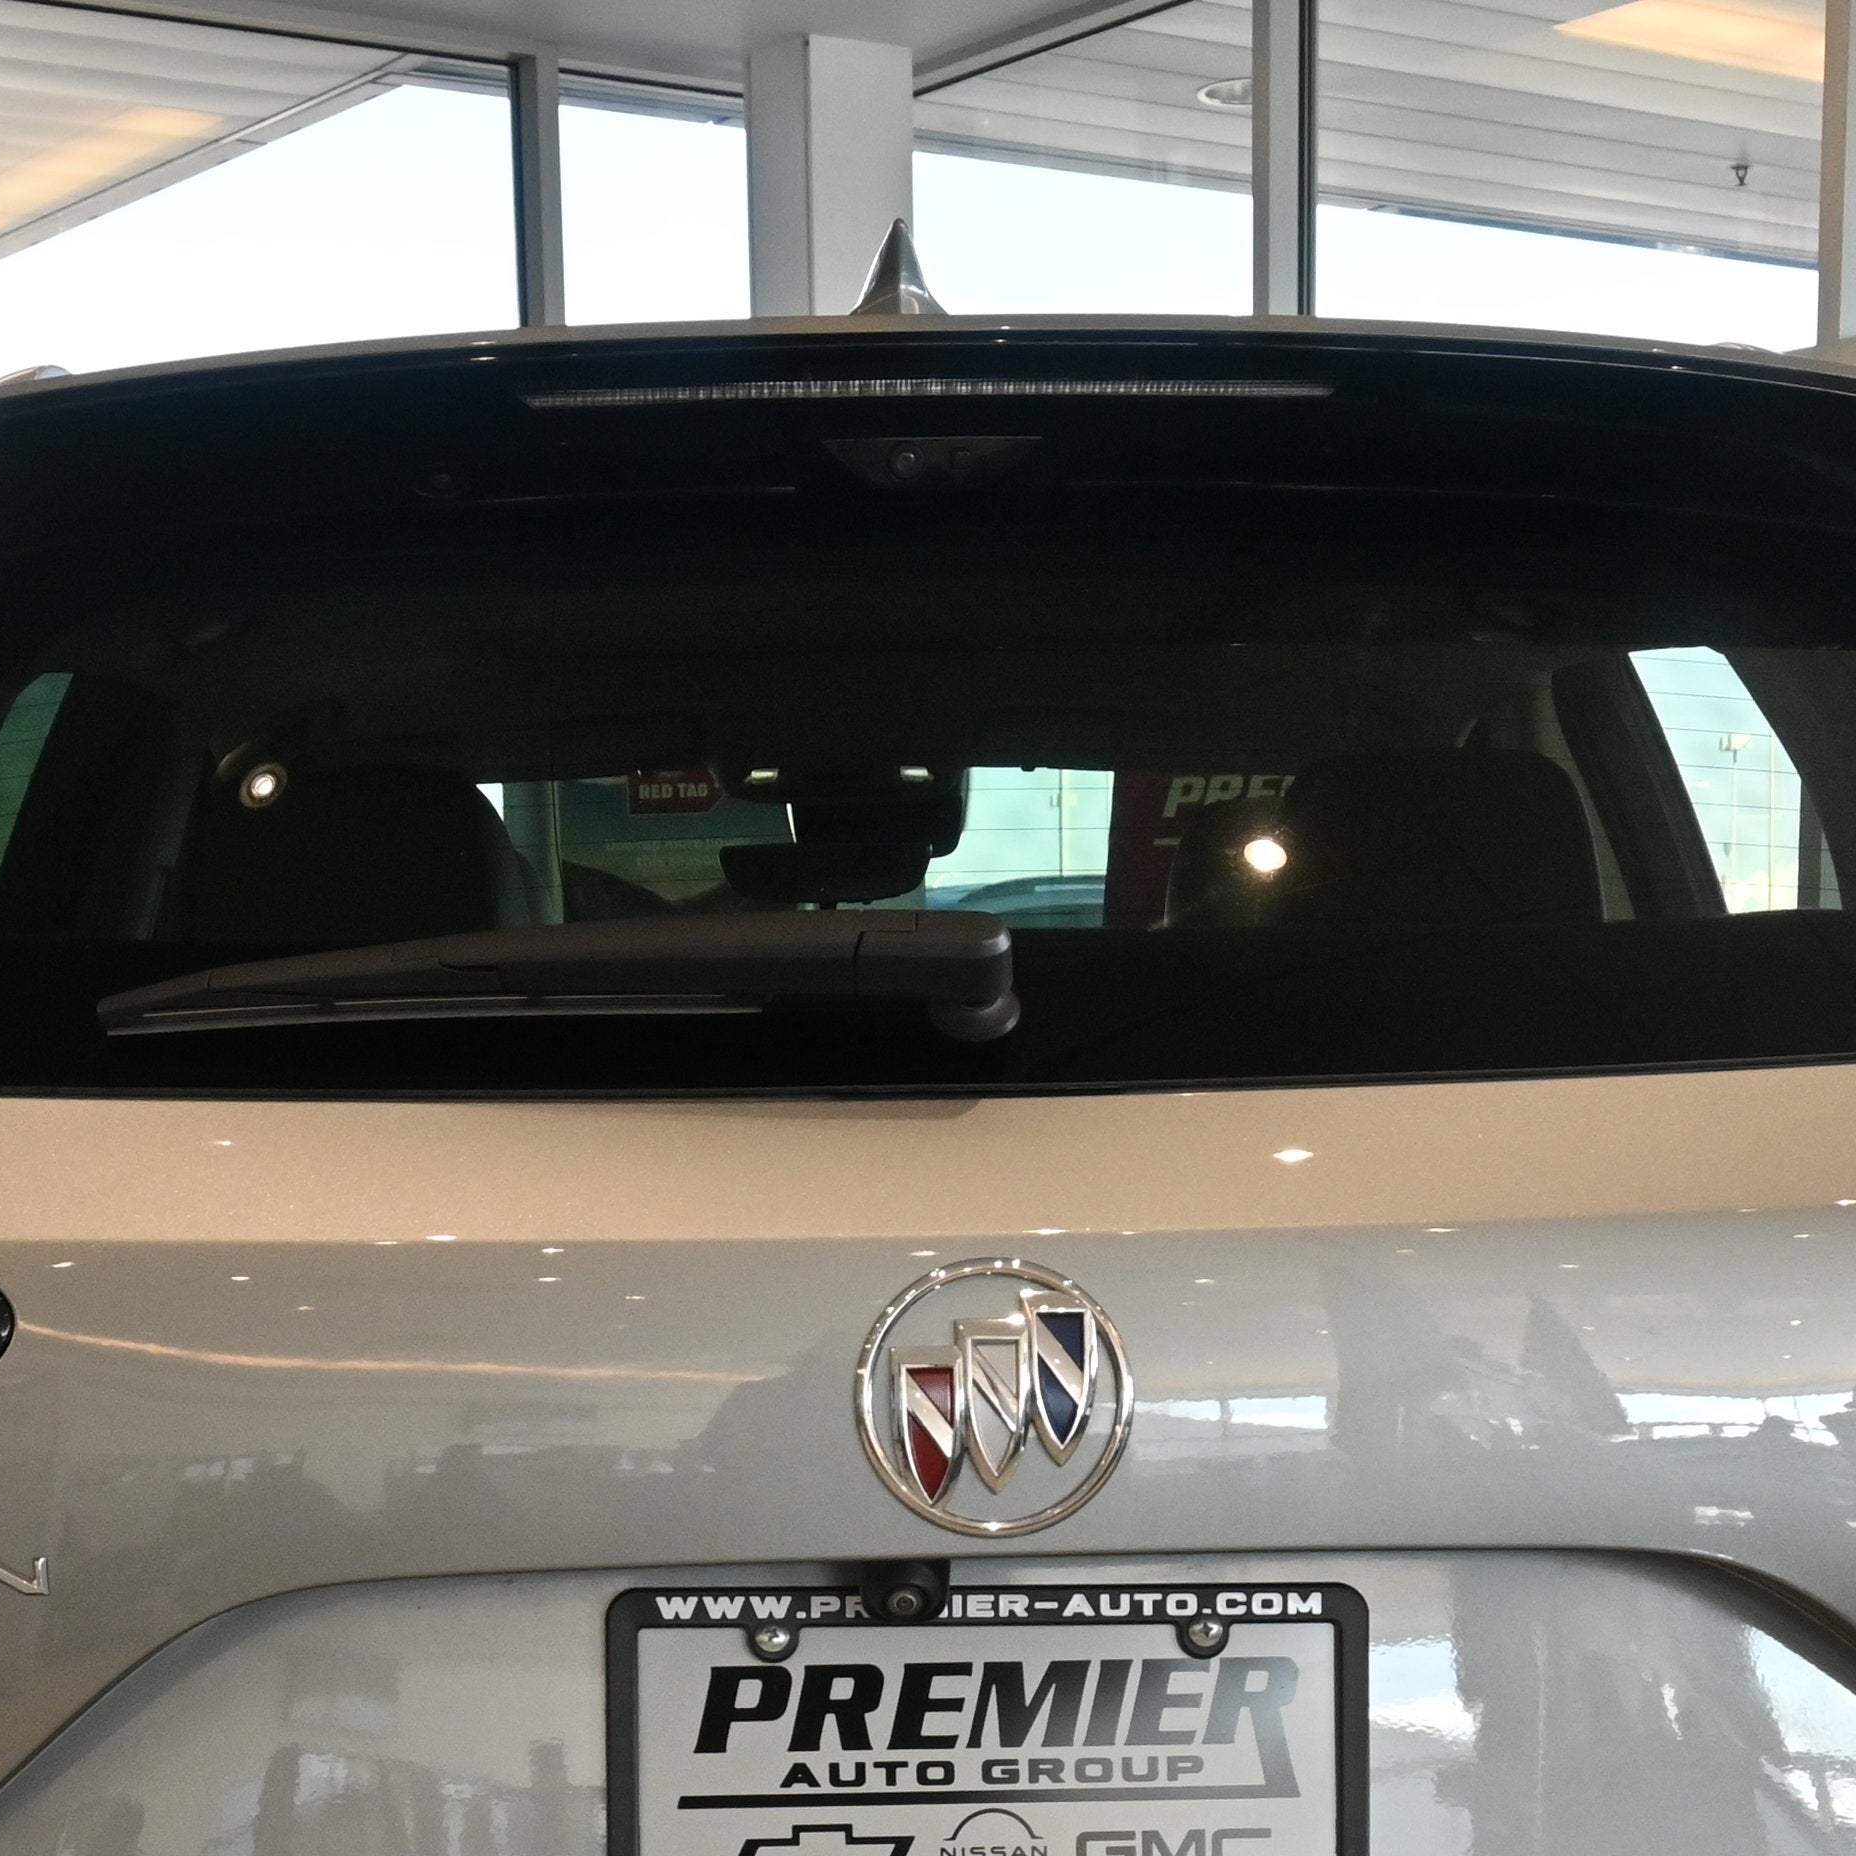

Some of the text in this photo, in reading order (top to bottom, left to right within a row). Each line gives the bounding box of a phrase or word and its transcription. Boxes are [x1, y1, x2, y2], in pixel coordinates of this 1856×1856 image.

[639, 782, 708, 799] RED TAG
[656, 1592, 1324, 1621] WWW.PRIER-AUTO.COM
[693, 1656, 1300, 1797] PREMIER
[779, 1755, 1205, 1789] AUTO GROUP
